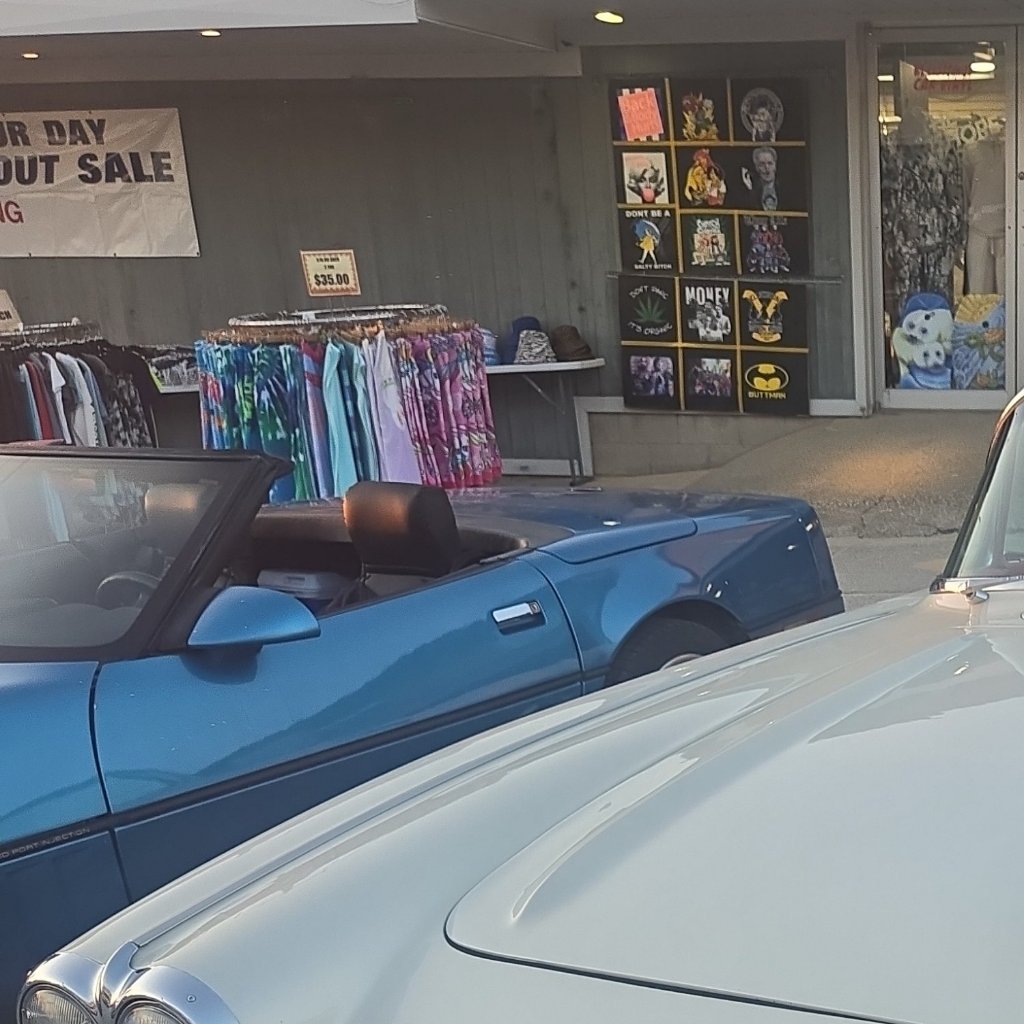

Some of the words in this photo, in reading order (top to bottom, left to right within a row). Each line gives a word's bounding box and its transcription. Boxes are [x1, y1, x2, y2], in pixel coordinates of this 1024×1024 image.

[43, 118, 106, 146] DAY
[78, 151, 175, 184] SALE
[314, 273, 350, 287] $35.00
[685, 286, 729, 306] MONEY
[748, 391, 786, 400] BUTTMAN
[12, 842, 40, 855] PORT
[41, 828, 90, 845] INJECTION
